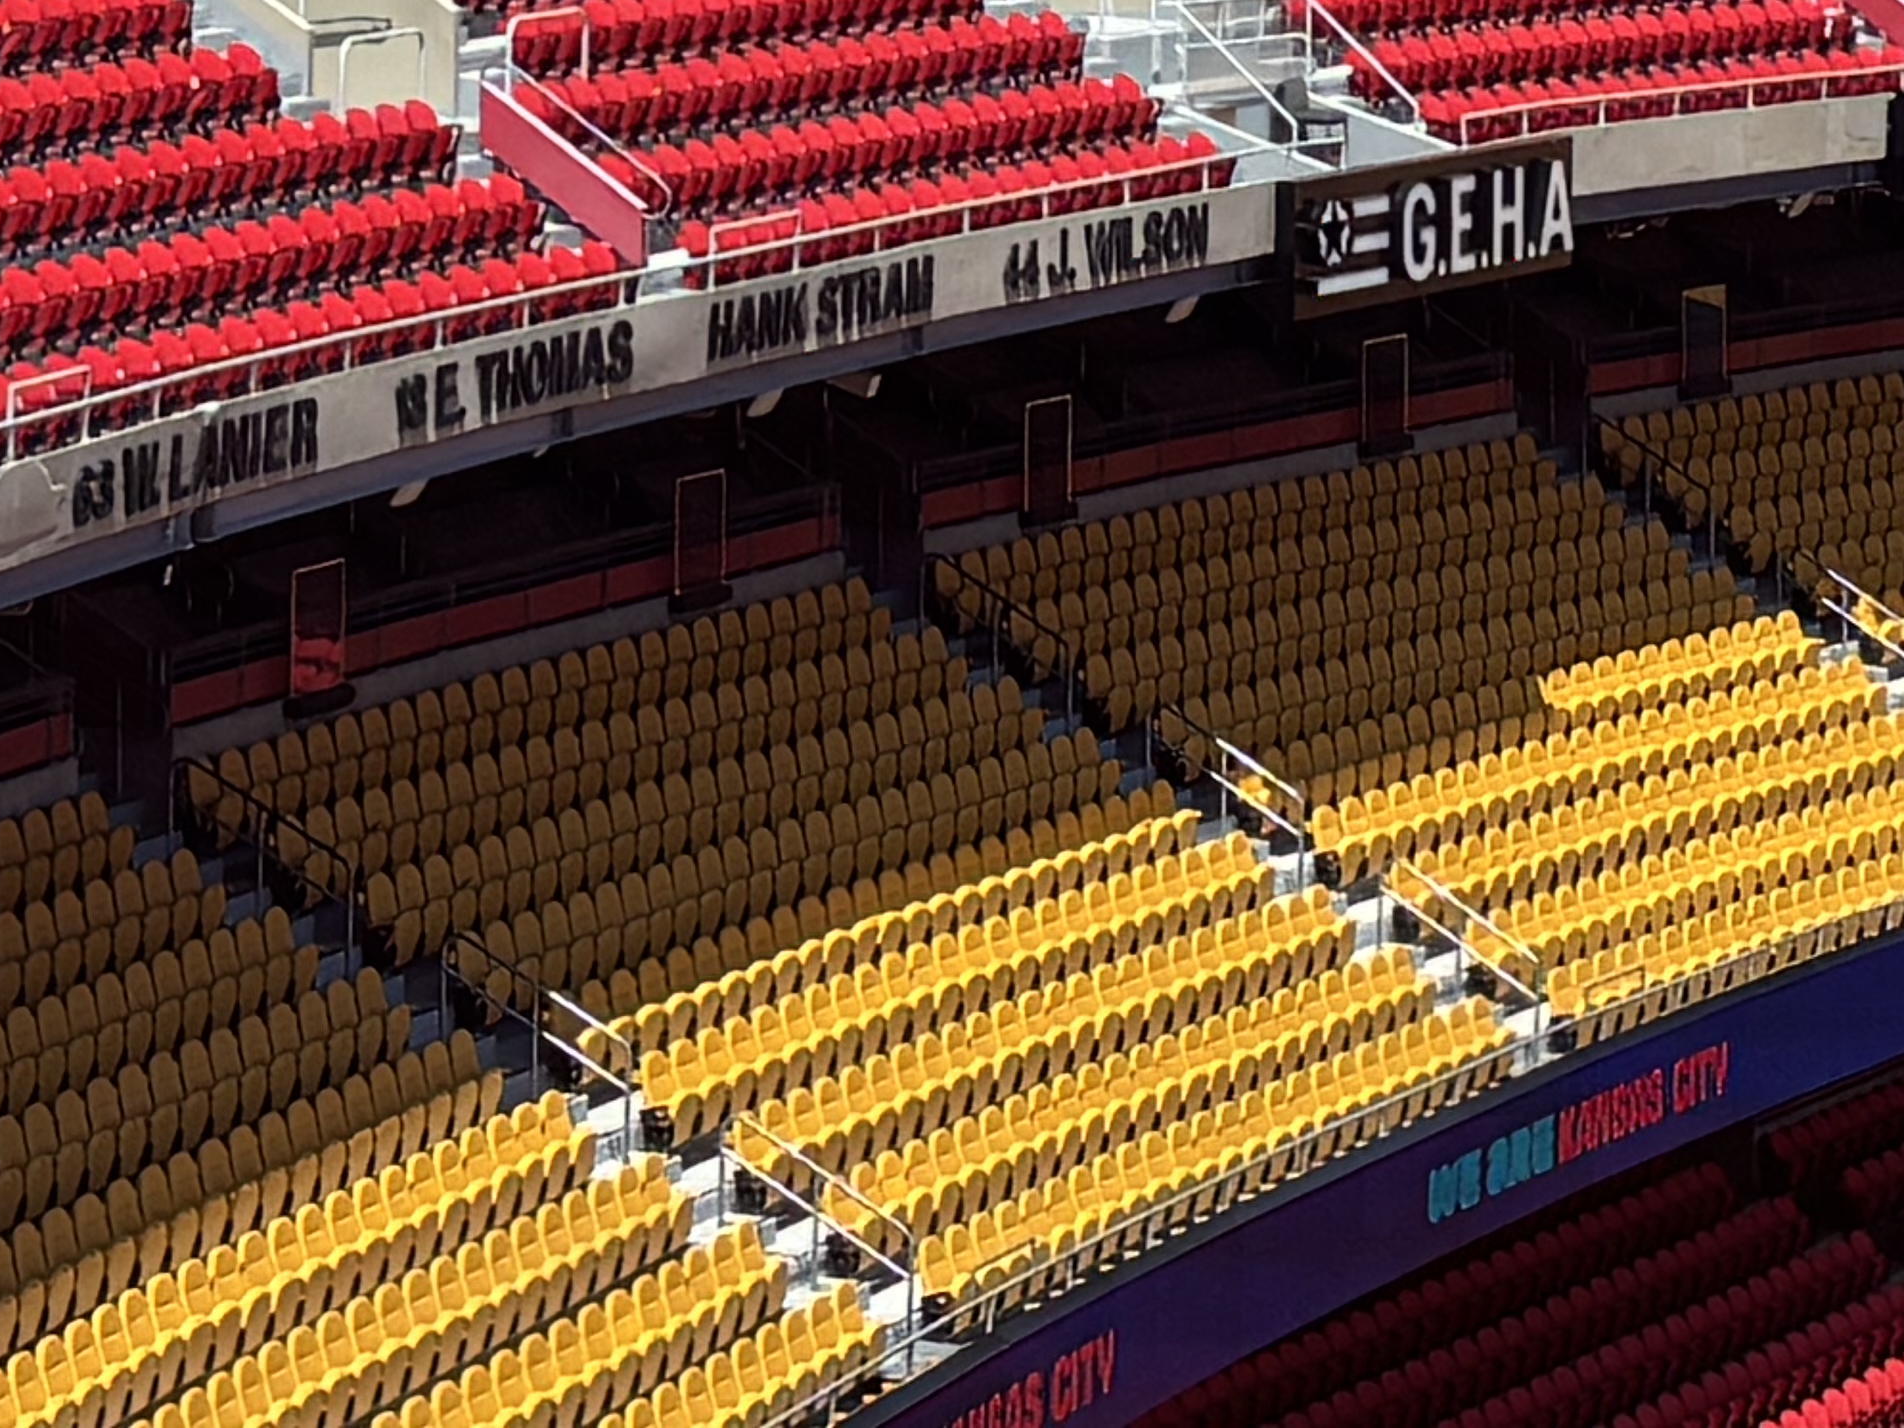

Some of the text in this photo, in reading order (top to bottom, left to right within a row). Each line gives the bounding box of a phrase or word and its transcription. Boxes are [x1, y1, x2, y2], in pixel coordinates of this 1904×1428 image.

[1048, 227, 1077, 291] J.
[1084, 202, 1210, 282] WILSON
[707, 254, 934, 361] HANK STRAM
[475, 320, 634, 423] THOMAS
[168, 397, 318, 502] LANIER
[1558, 1068, 1664, 1166] KANSAS
[1672, 1041, 1729, 1114] CITY
[1051, 1329, 1115, 1422] CITY
